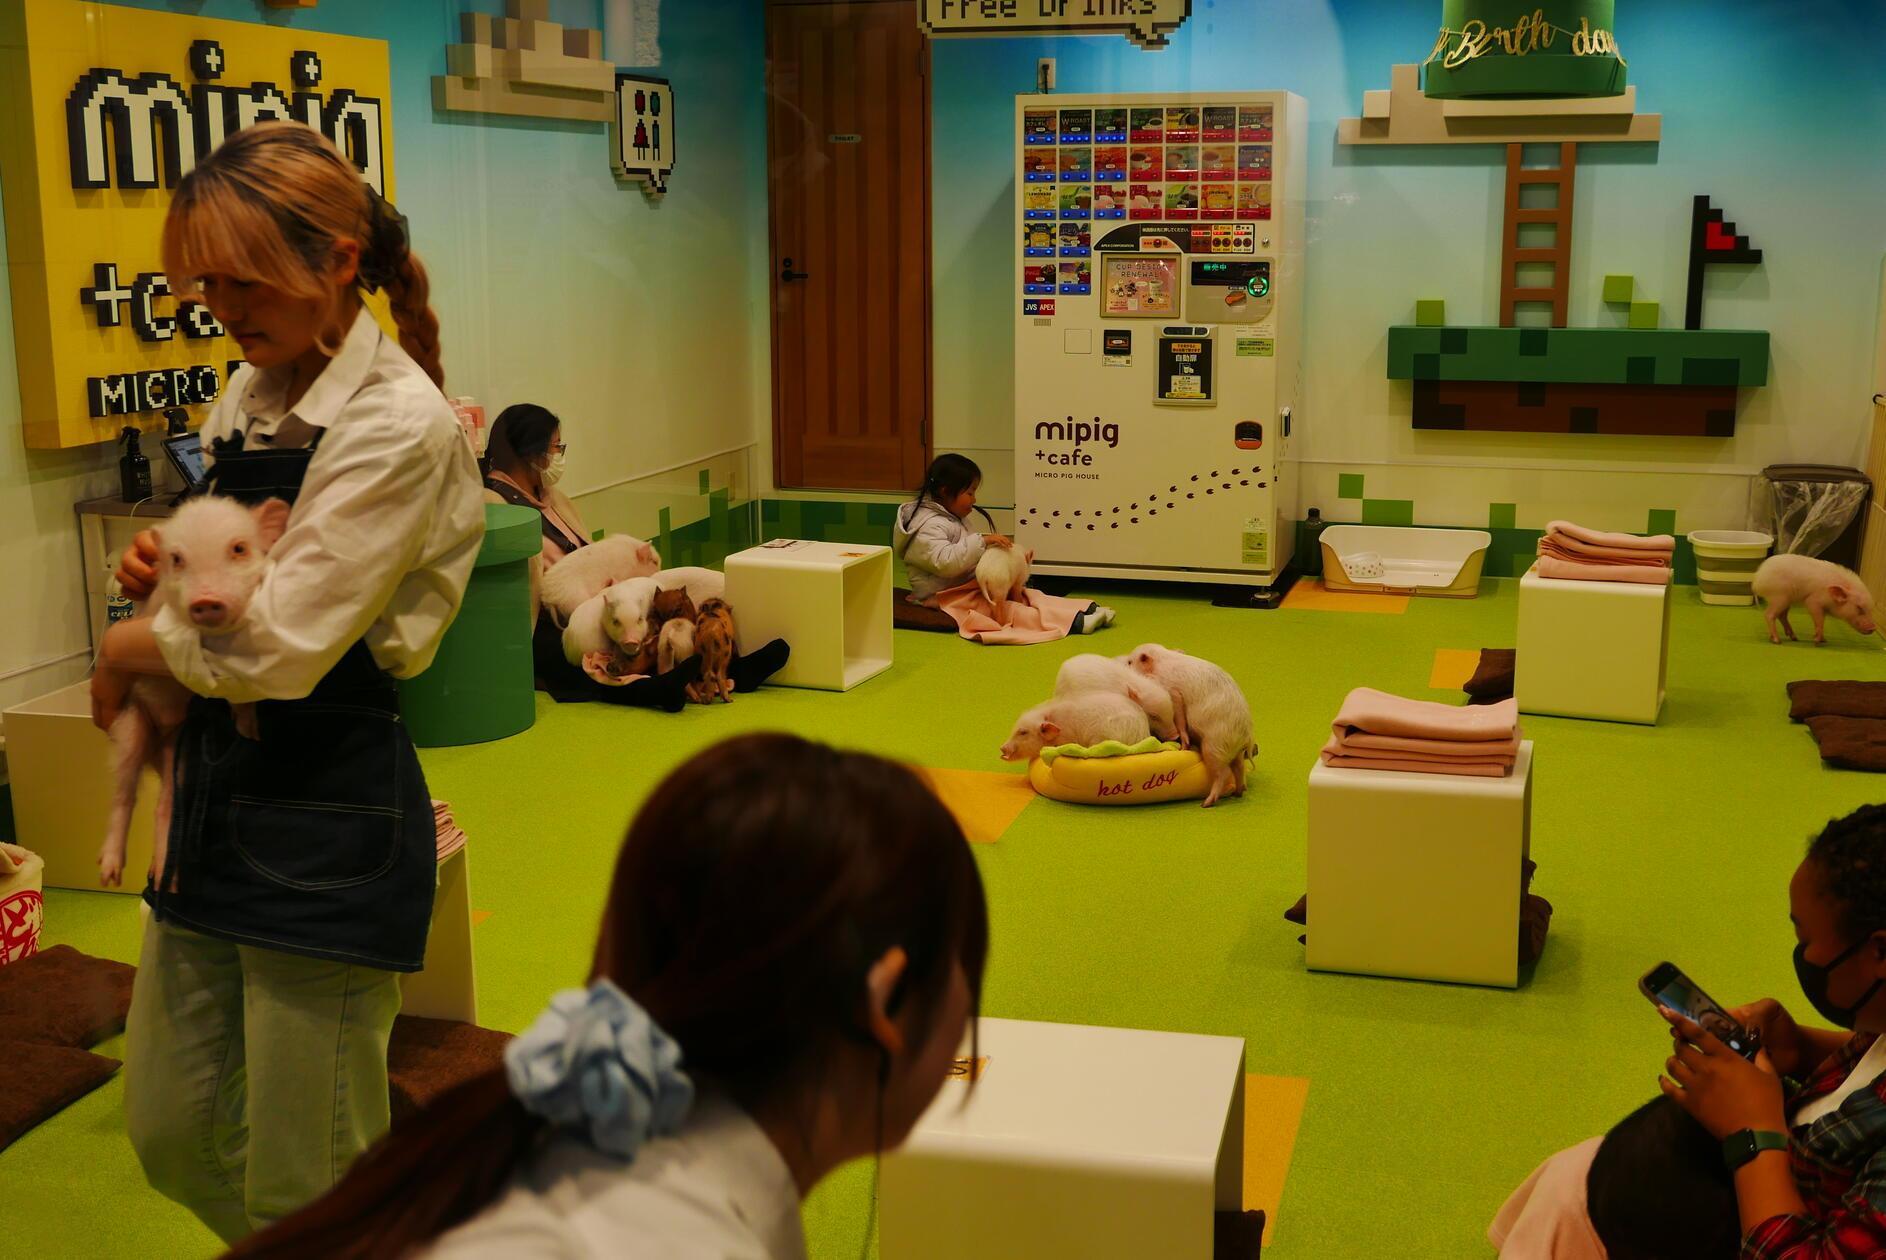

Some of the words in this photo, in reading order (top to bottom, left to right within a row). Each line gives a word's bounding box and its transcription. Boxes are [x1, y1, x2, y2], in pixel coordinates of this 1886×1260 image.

[86, 365, 219, 418] MICRO
[1034, 415, 1119, 448] mipig
[1035, 448, 1093, 466] +cafe
[1060, 472, 1073, 480] PIG
[1097, 779, 1133, 797] hot
[1142, 769, 1180, 792] dog
